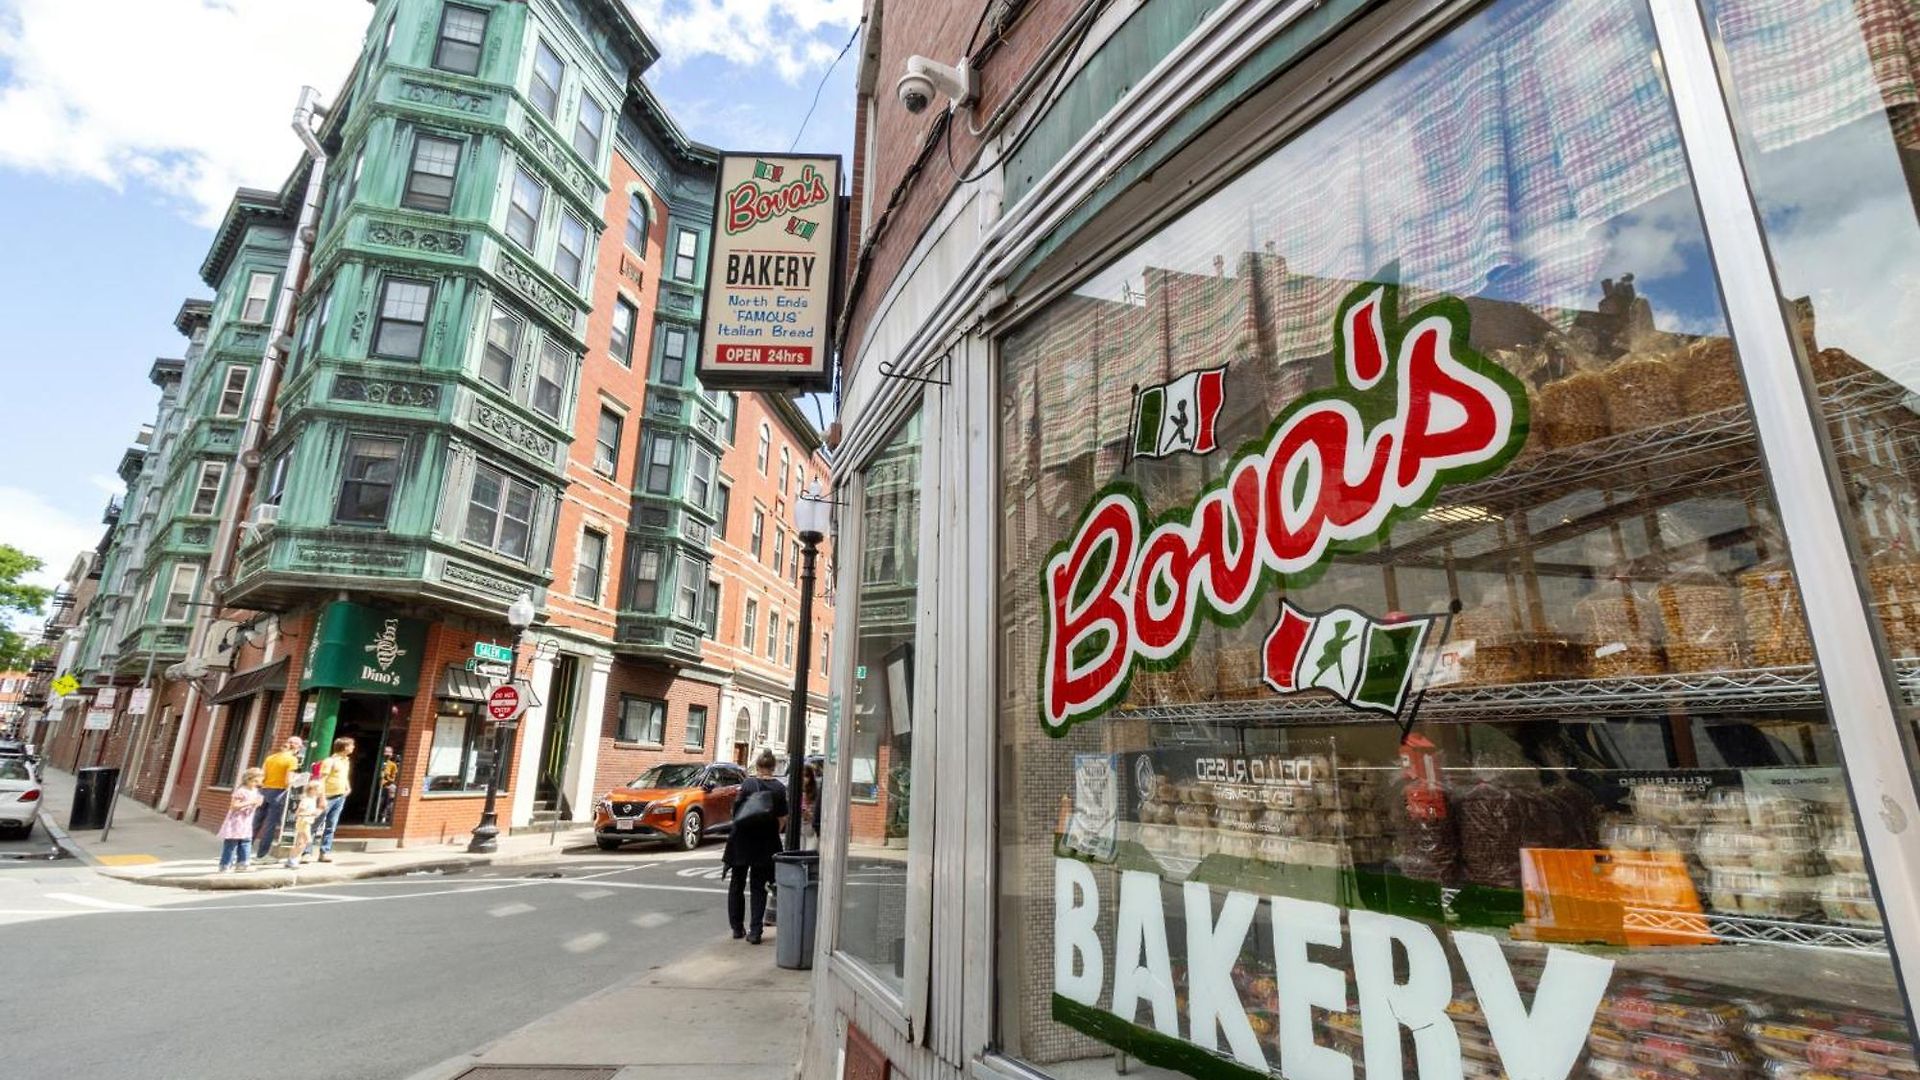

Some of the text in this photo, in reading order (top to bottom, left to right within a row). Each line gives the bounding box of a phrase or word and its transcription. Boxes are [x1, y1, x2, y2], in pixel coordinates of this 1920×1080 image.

[726, 165, 828, 234] Bova's
[726, 254, 816, 287] BAKERY
[728, 295, 768, 307] North
[718, 323, 814, 337] Italian Bread
[726, 348, 804, 363] OPEN 24hrs
[1044, 284, 1516, 728] Bova's
[361, 665, 401, 687] Dino's
[1053, 858, 1615, 1080] BAKERY
